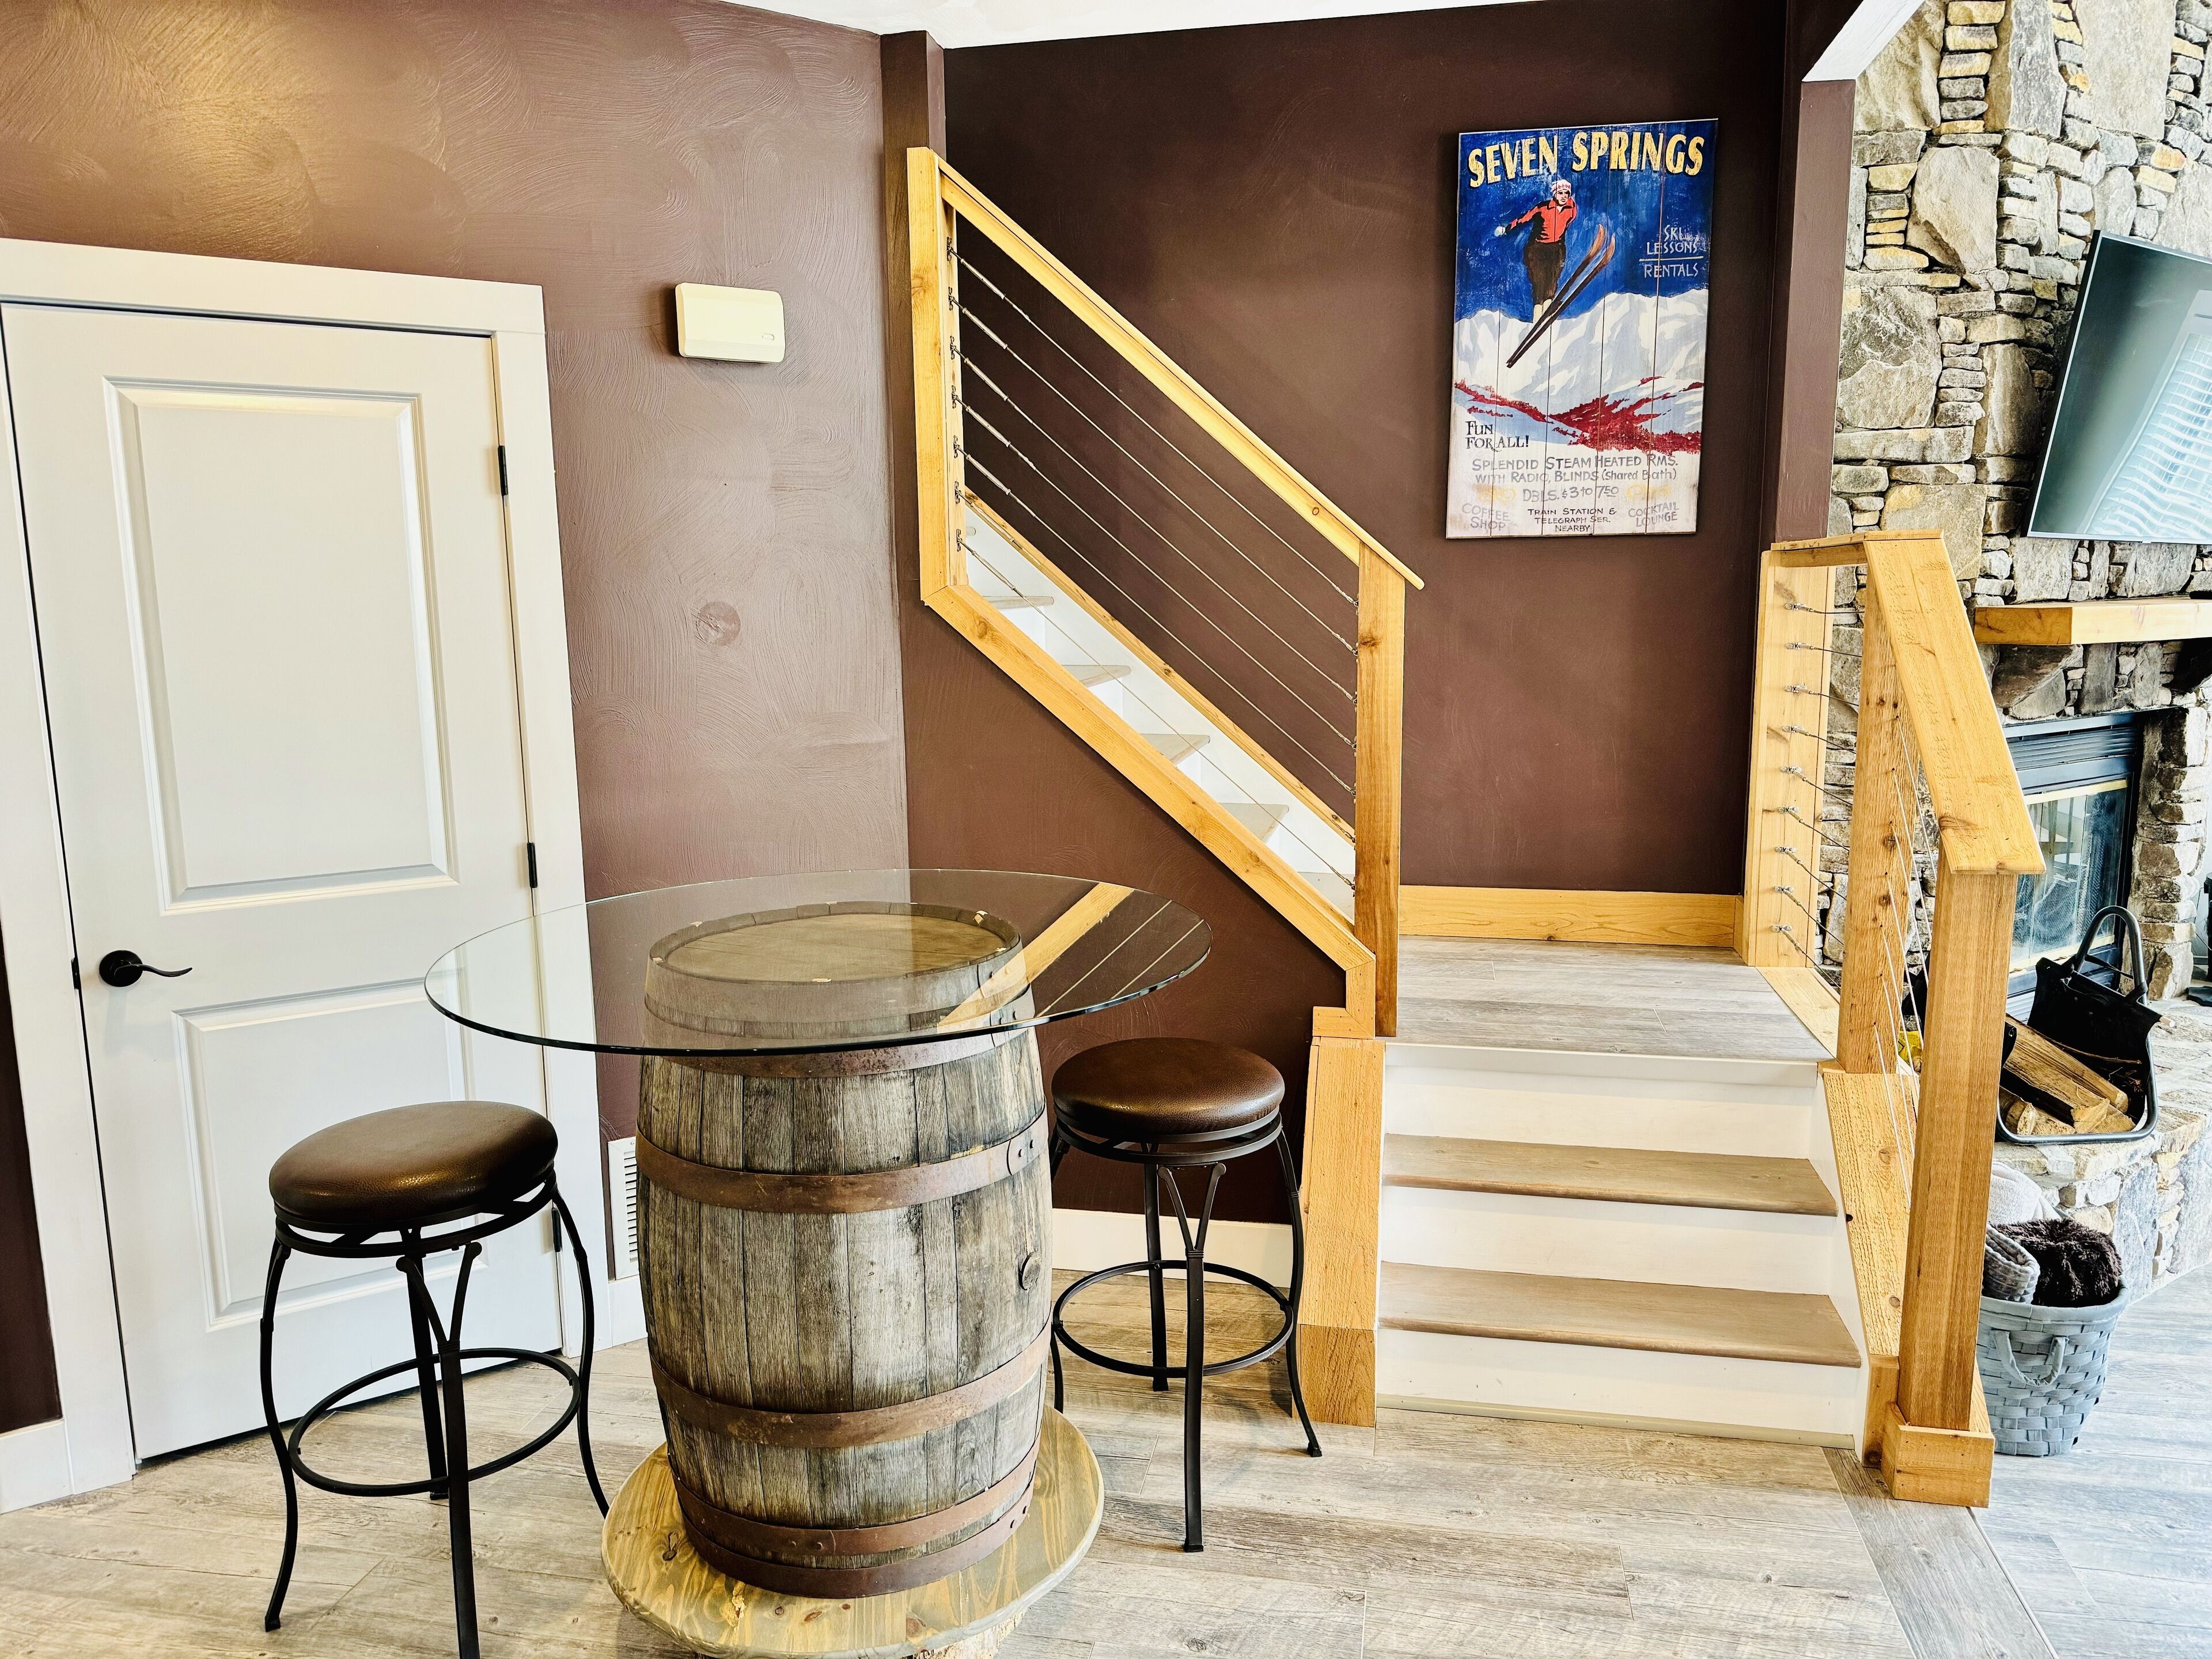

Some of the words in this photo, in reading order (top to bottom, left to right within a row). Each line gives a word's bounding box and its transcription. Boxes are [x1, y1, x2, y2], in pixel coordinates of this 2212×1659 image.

[1468, 135, 1558, 188] SEVEN
[1572, 131, 1706, 176] SPRINGS
[1647, 235, 1699, 255] LESSONS
[1643, 263, 1699, 278] RENTALS
[1465, 437, 1502, 452] FOR
[1497, 435, 1529, 448] ALL!
[1472, 459, 1539, 471] SPLENDID
[1546, 456, 1591, 470] STEAM
[1594, 455, 1642, 468] HEATED
[1646, 453, 1679, 467] RMS.
[1510, 471, 1551, 484] RADIO,
[1554, 470, 1599, 482] BLINDS
[1642, 468, 1677, 480] Bath)
[1522, 488, 1560, 503] DBLS.
[1461, 503, 1510, 522] COFFEE
[1527, 508, 1557, 516] TRAIN
[1562, 507, 1603, 516] STATION
[1628, 502, 1680, 518] COCKTAIL
[1469, 516, 1506, 532] SHOP
[1590, 516, 1611, 524] SER.
[1635, 511, 1678, 528] LOUNGE
[1555, 525, 1590, 533] NEARBY
